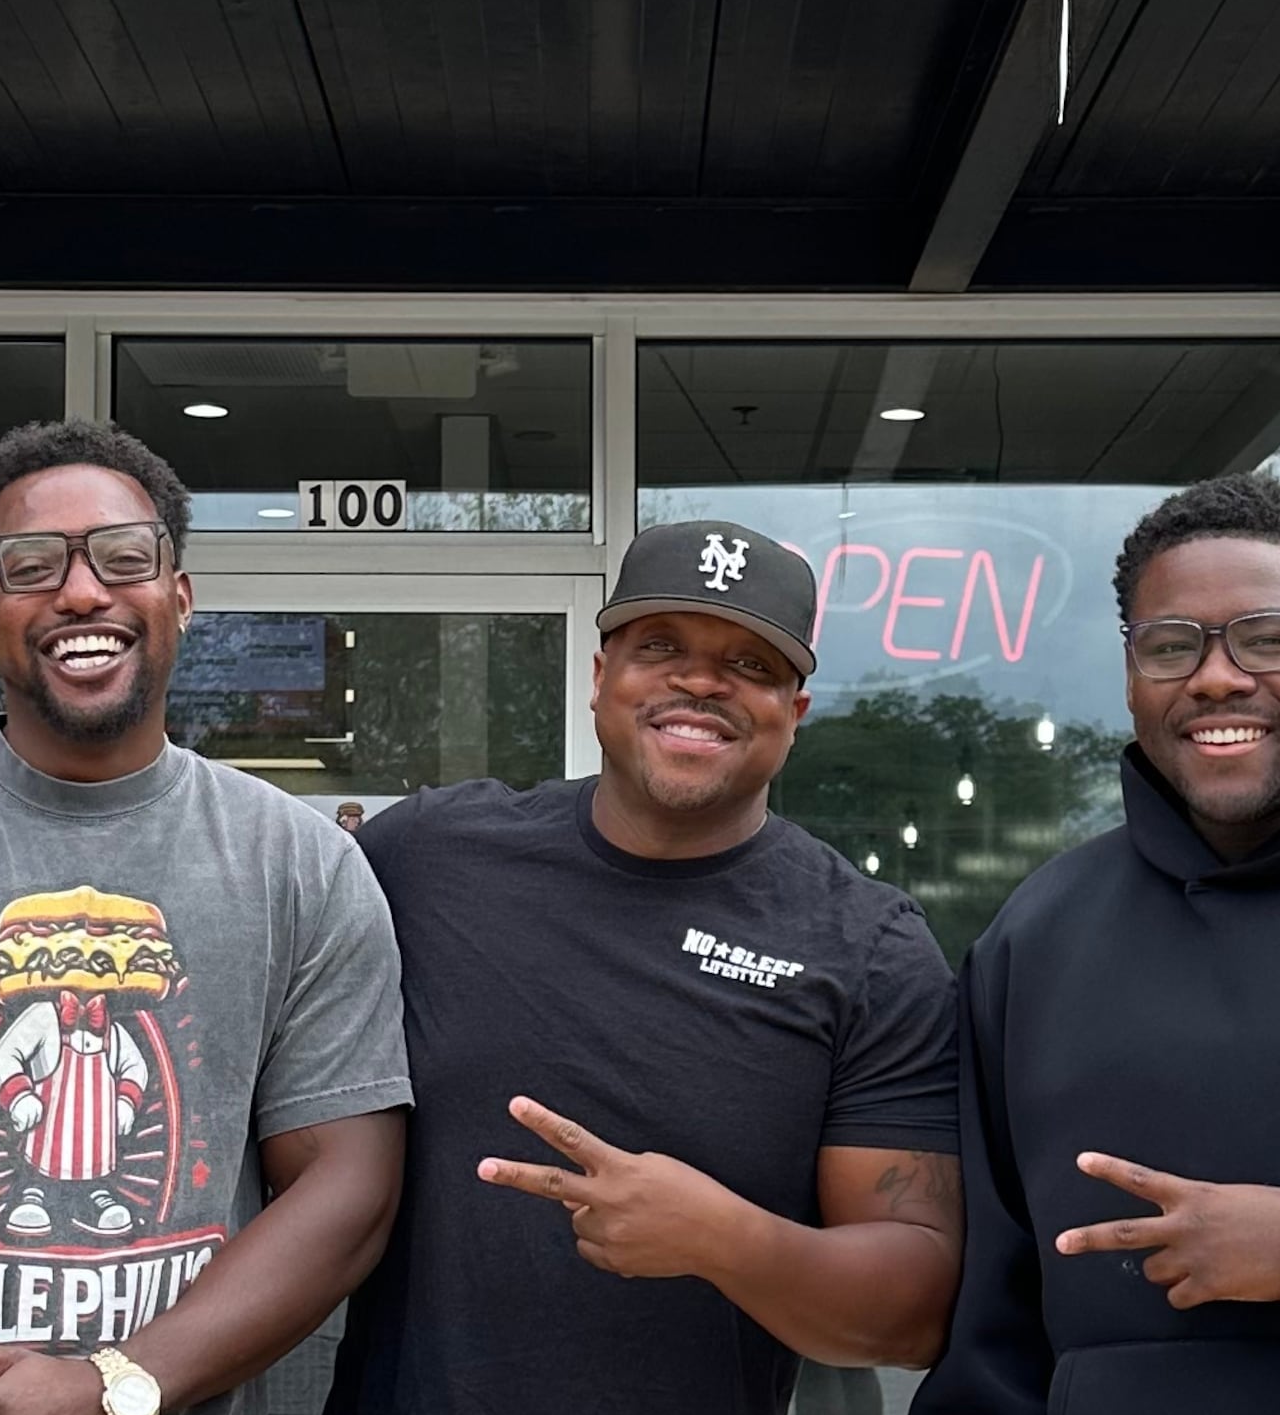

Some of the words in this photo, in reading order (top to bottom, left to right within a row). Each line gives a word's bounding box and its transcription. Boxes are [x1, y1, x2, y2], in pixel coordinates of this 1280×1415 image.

[308, 484, 403, 528] 100
[780, 542, 1045, 663] PEN
[700, 957, 777, 988] LIFESTYLE
